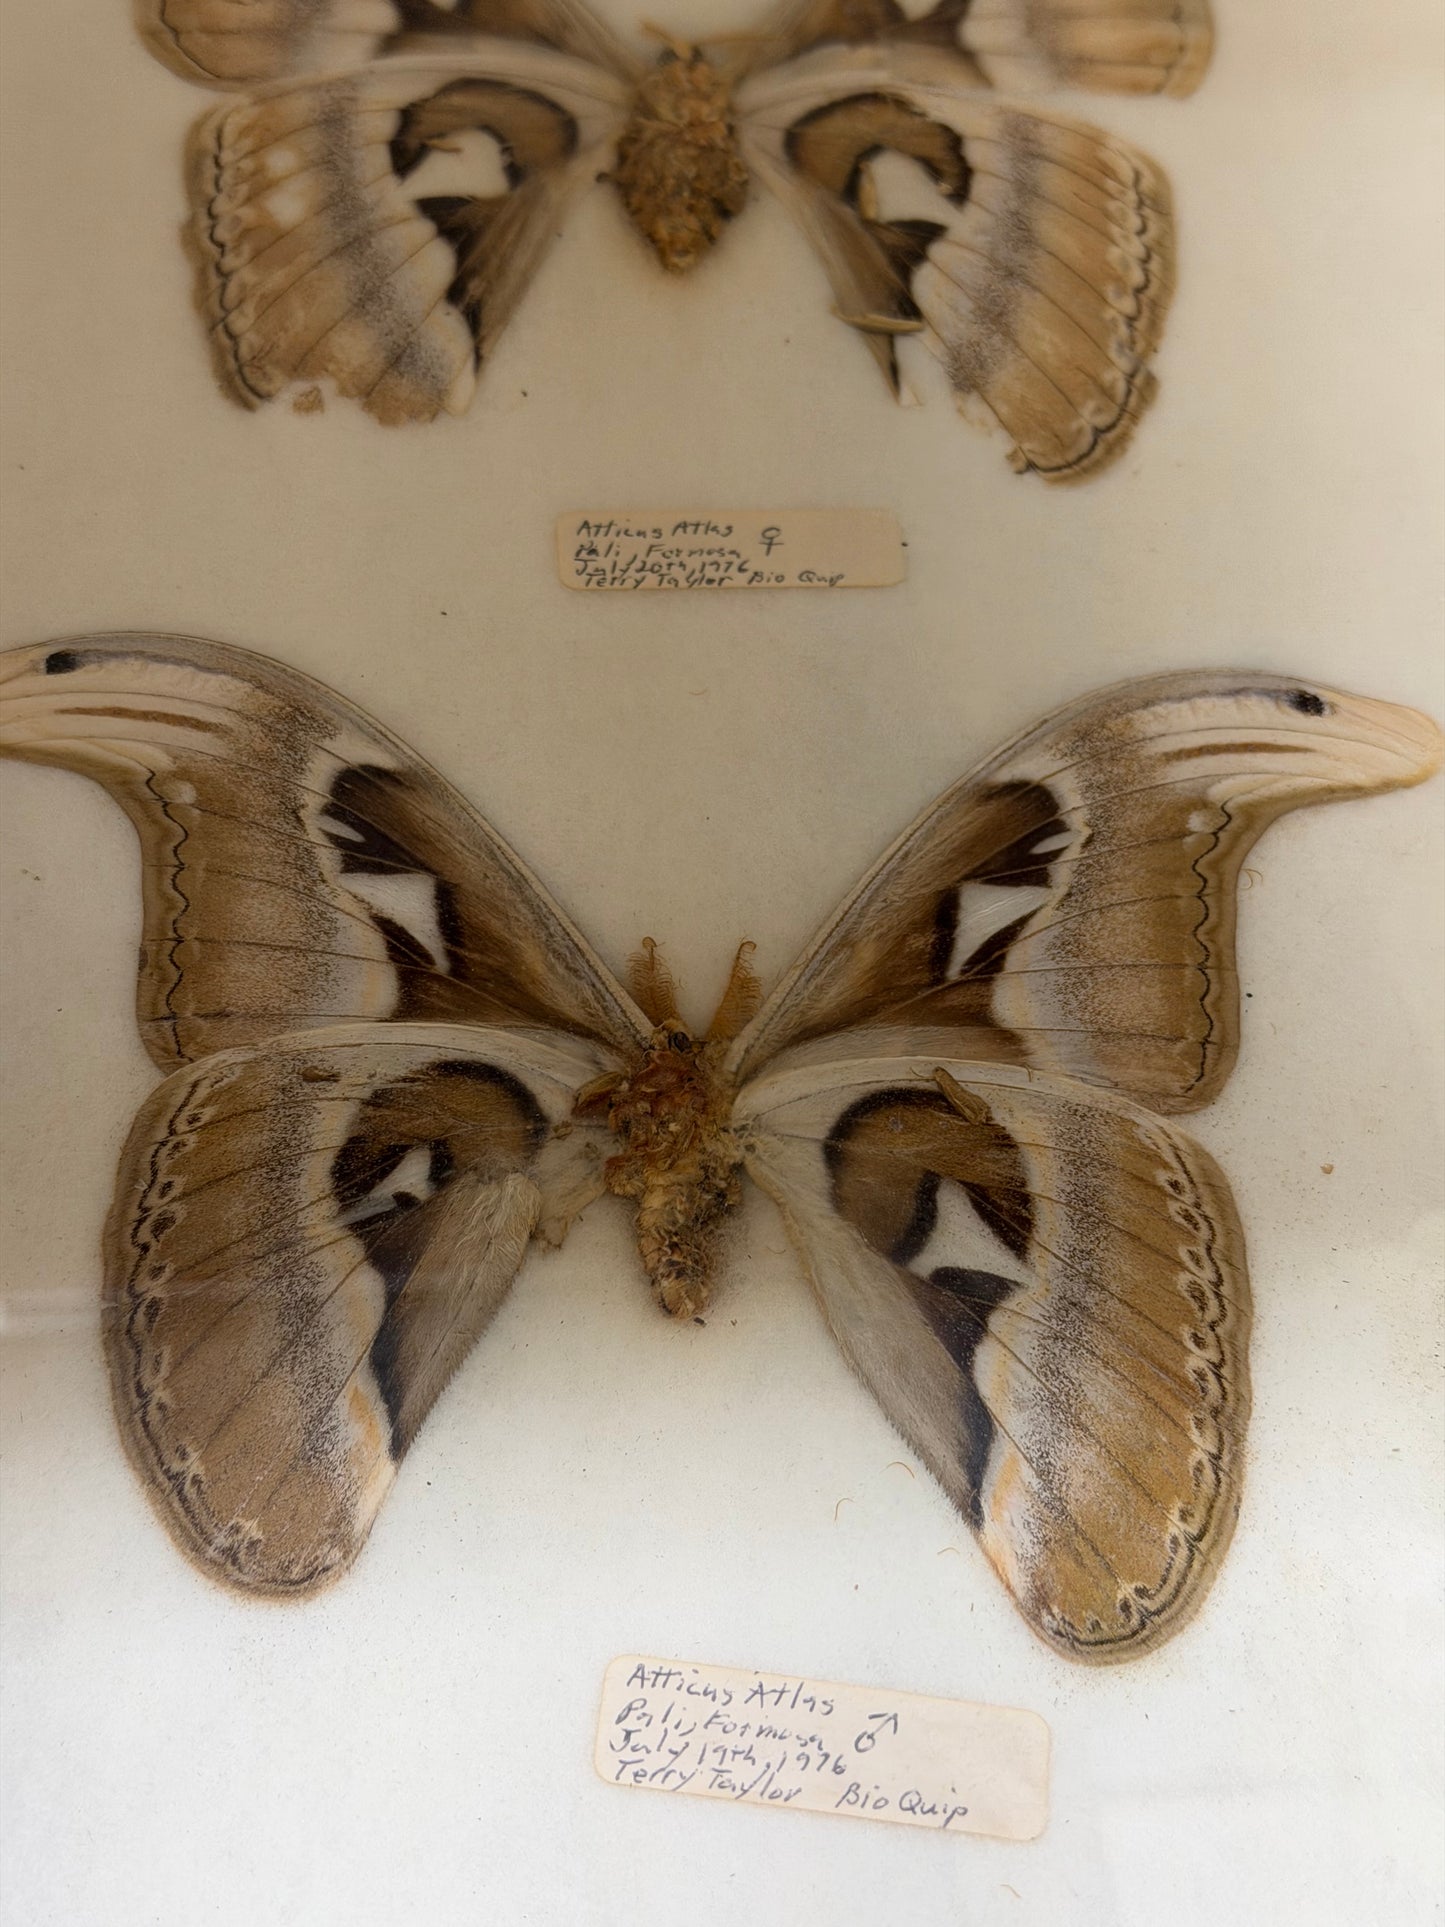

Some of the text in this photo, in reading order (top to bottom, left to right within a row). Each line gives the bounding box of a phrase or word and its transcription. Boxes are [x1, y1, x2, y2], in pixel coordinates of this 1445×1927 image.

[672, 520, 733, 537] Atlas
[585, 573, 646, 589] Terry
[658, 570, 733, 588] Taylor
[748, 571, 785, 585] Bio
[744, 1681, 834, 1716] Atlas
[609, 1727, 690, 1770] July
[615, 1759, 699, 1791] Terry
[708, 1765, 802, 1802] Taylor
